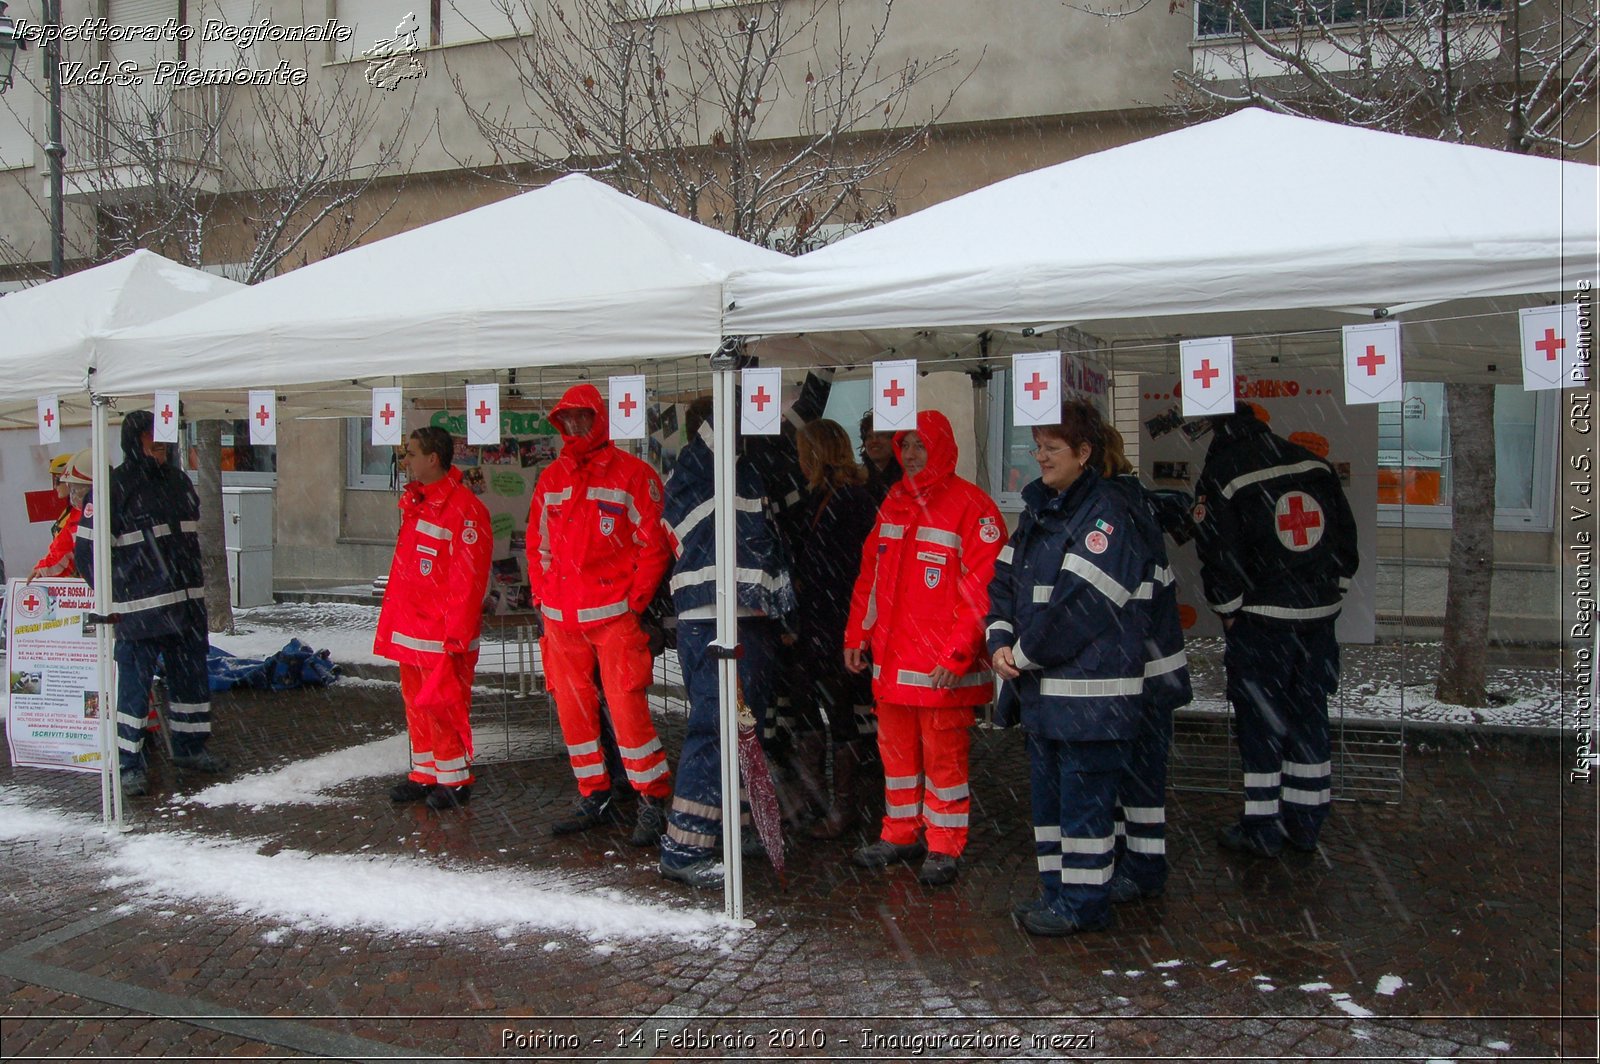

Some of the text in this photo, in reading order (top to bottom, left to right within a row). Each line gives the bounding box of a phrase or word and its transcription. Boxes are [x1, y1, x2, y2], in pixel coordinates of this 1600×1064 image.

[48, 586, 66, 597] CROCE
[68, 587, 86, 597] ROSSA
[59, 599, 91, 609] Comitato Locale
